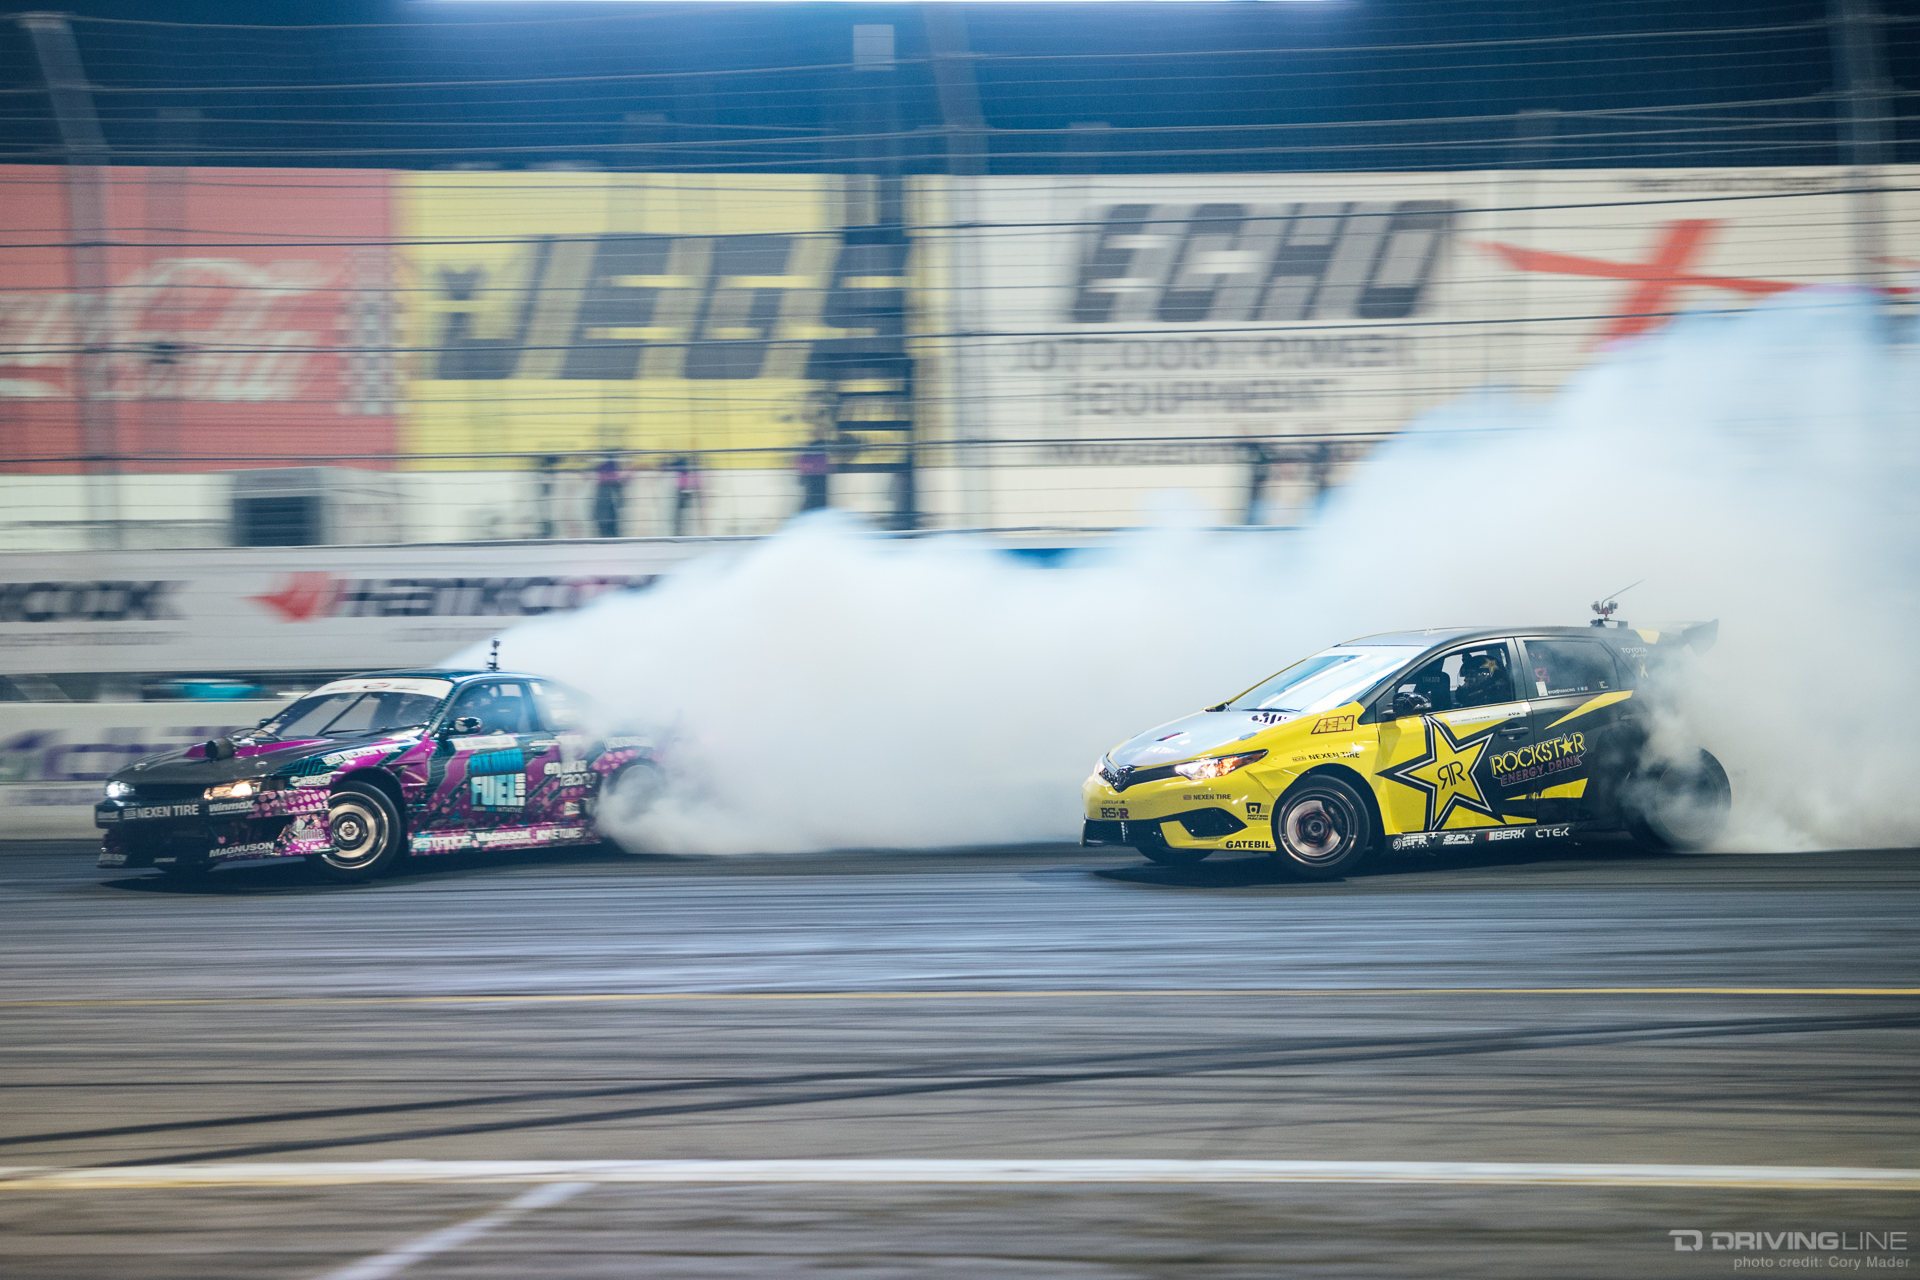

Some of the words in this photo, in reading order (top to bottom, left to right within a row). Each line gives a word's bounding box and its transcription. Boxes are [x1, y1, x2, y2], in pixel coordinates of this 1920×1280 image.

[1311, 715, 1354, 734] AEM
[1308, 752, 1340, 760] NEXEN
[1342, 751, 1360, 759] TIRE
[1501, 764, 1544, 785] ENERGY
[1548, 755, 1581, 772] DRINK
[137, 806, 171, 818] NEXEN
[172, 804, 199, 816] TIRE
[1495, 829, 1526, 841] BERK
[1535, 827, 1570, 838] CTEK
[209, 842, 274, 857] MAGNUSON
[1225, 840, 1271, 849] GATEBIL
